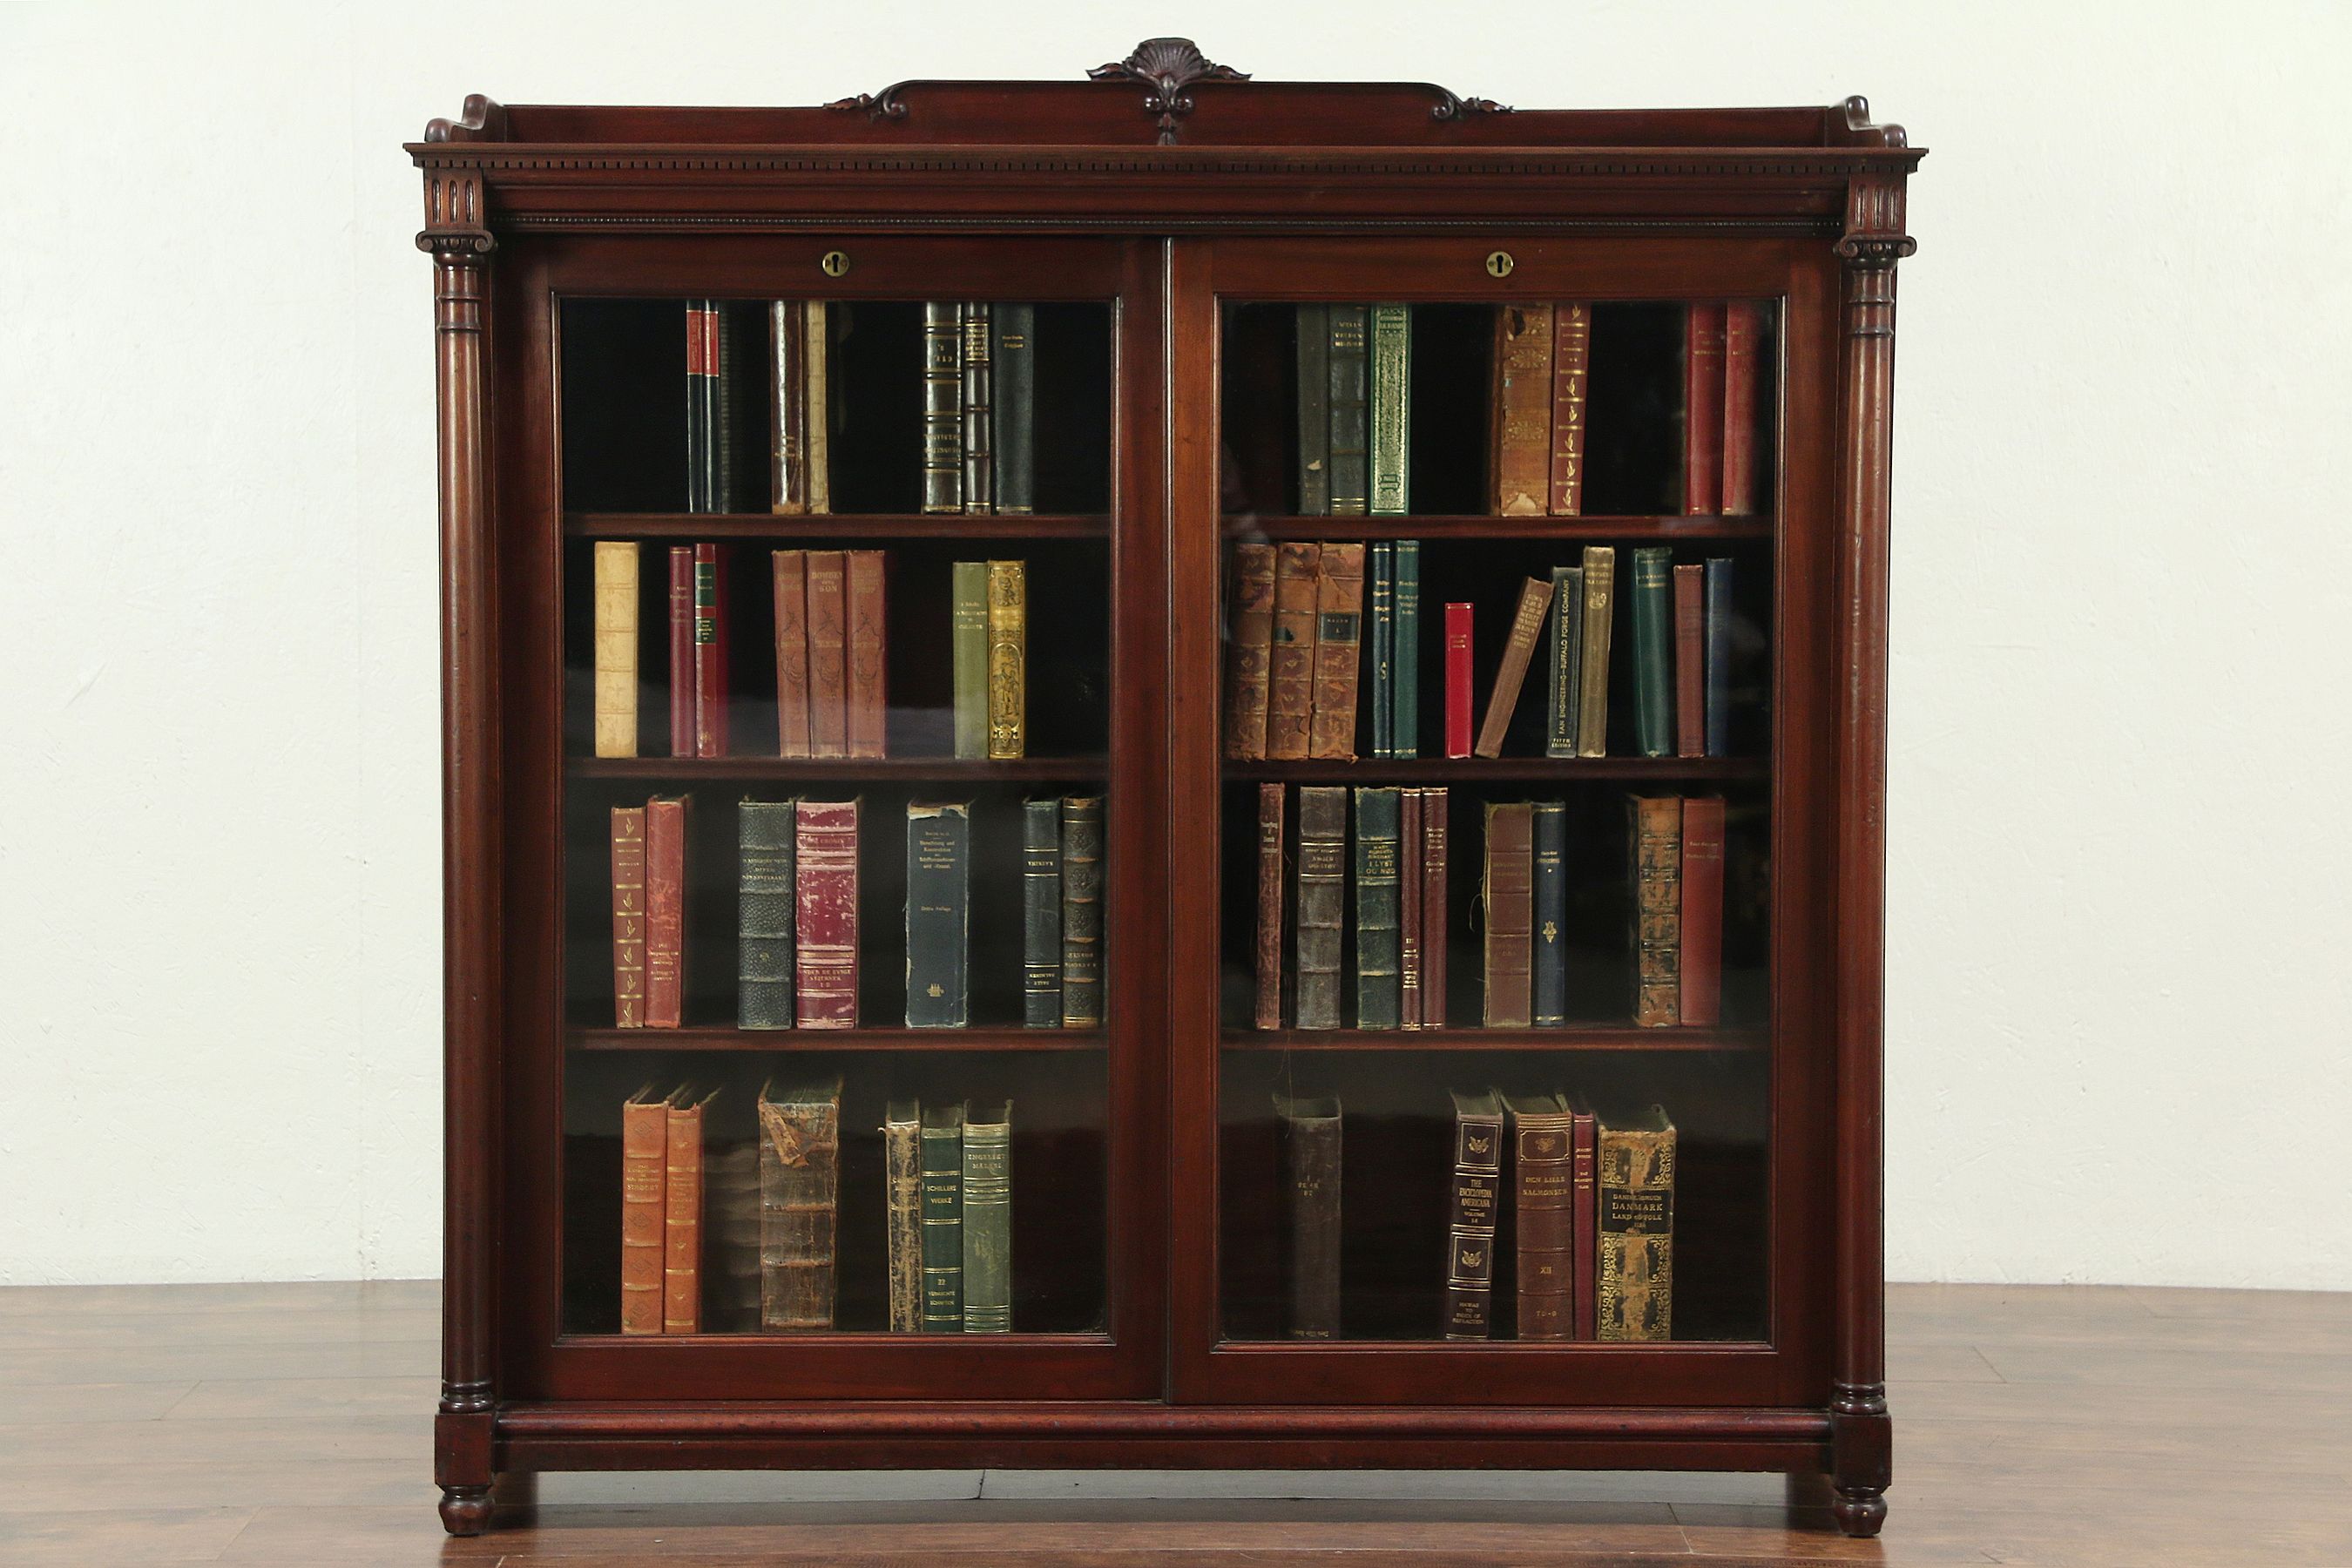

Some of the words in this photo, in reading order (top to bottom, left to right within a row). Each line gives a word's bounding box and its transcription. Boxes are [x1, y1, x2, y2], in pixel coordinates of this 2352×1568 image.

[1470, 1179, 1483, 1187] THE
[1522, 1188, 1568, 1197] SALMONSEN
[1461, 1198, 1490, 1207] AMERICANA
[1612, 1202, 1663, 1212] DANMARK
